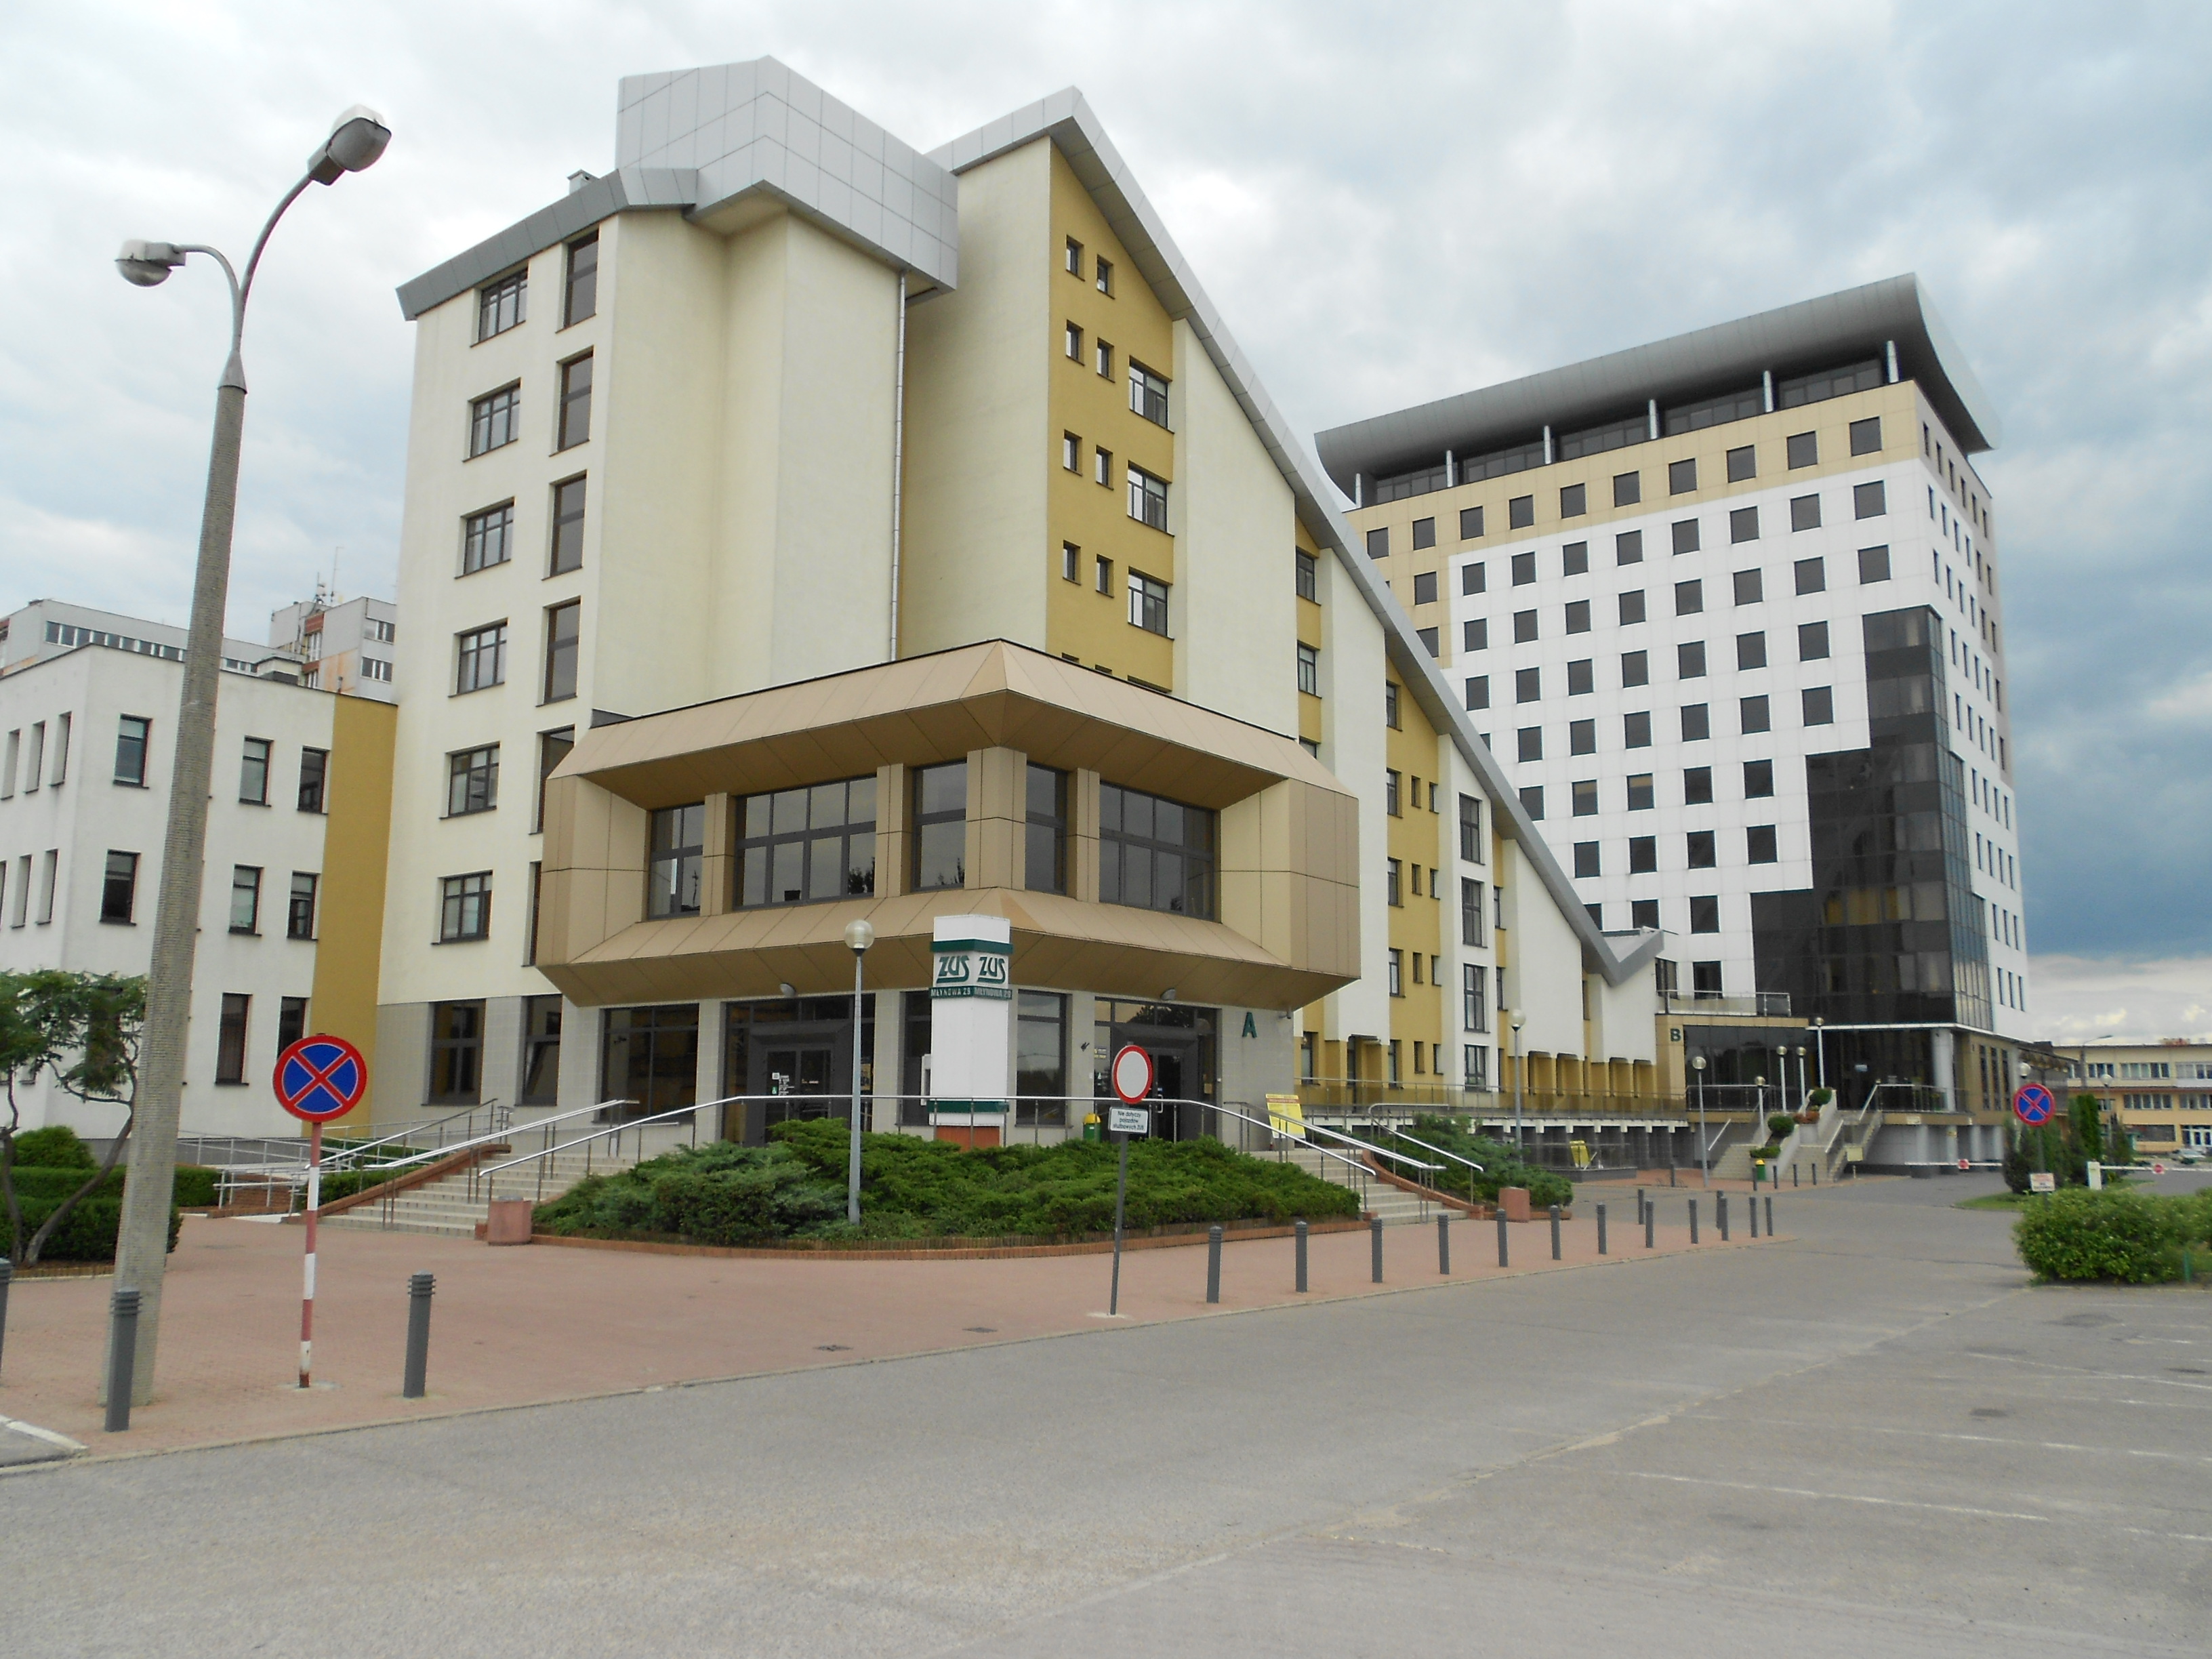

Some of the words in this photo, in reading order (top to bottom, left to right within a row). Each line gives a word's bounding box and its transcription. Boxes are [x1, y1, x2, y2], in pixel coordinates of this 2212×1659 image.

[936, 955, 970, 983] ZUS
[977, 956, 1006, 984] ZUS
[930, 987, 961, 997] MŁYNOWA
[974, 987, 1002, 998] MŁYNOWA
[1242, 1012, 1257, 1038] A
[1670, 1028, 1681, 1042] B
